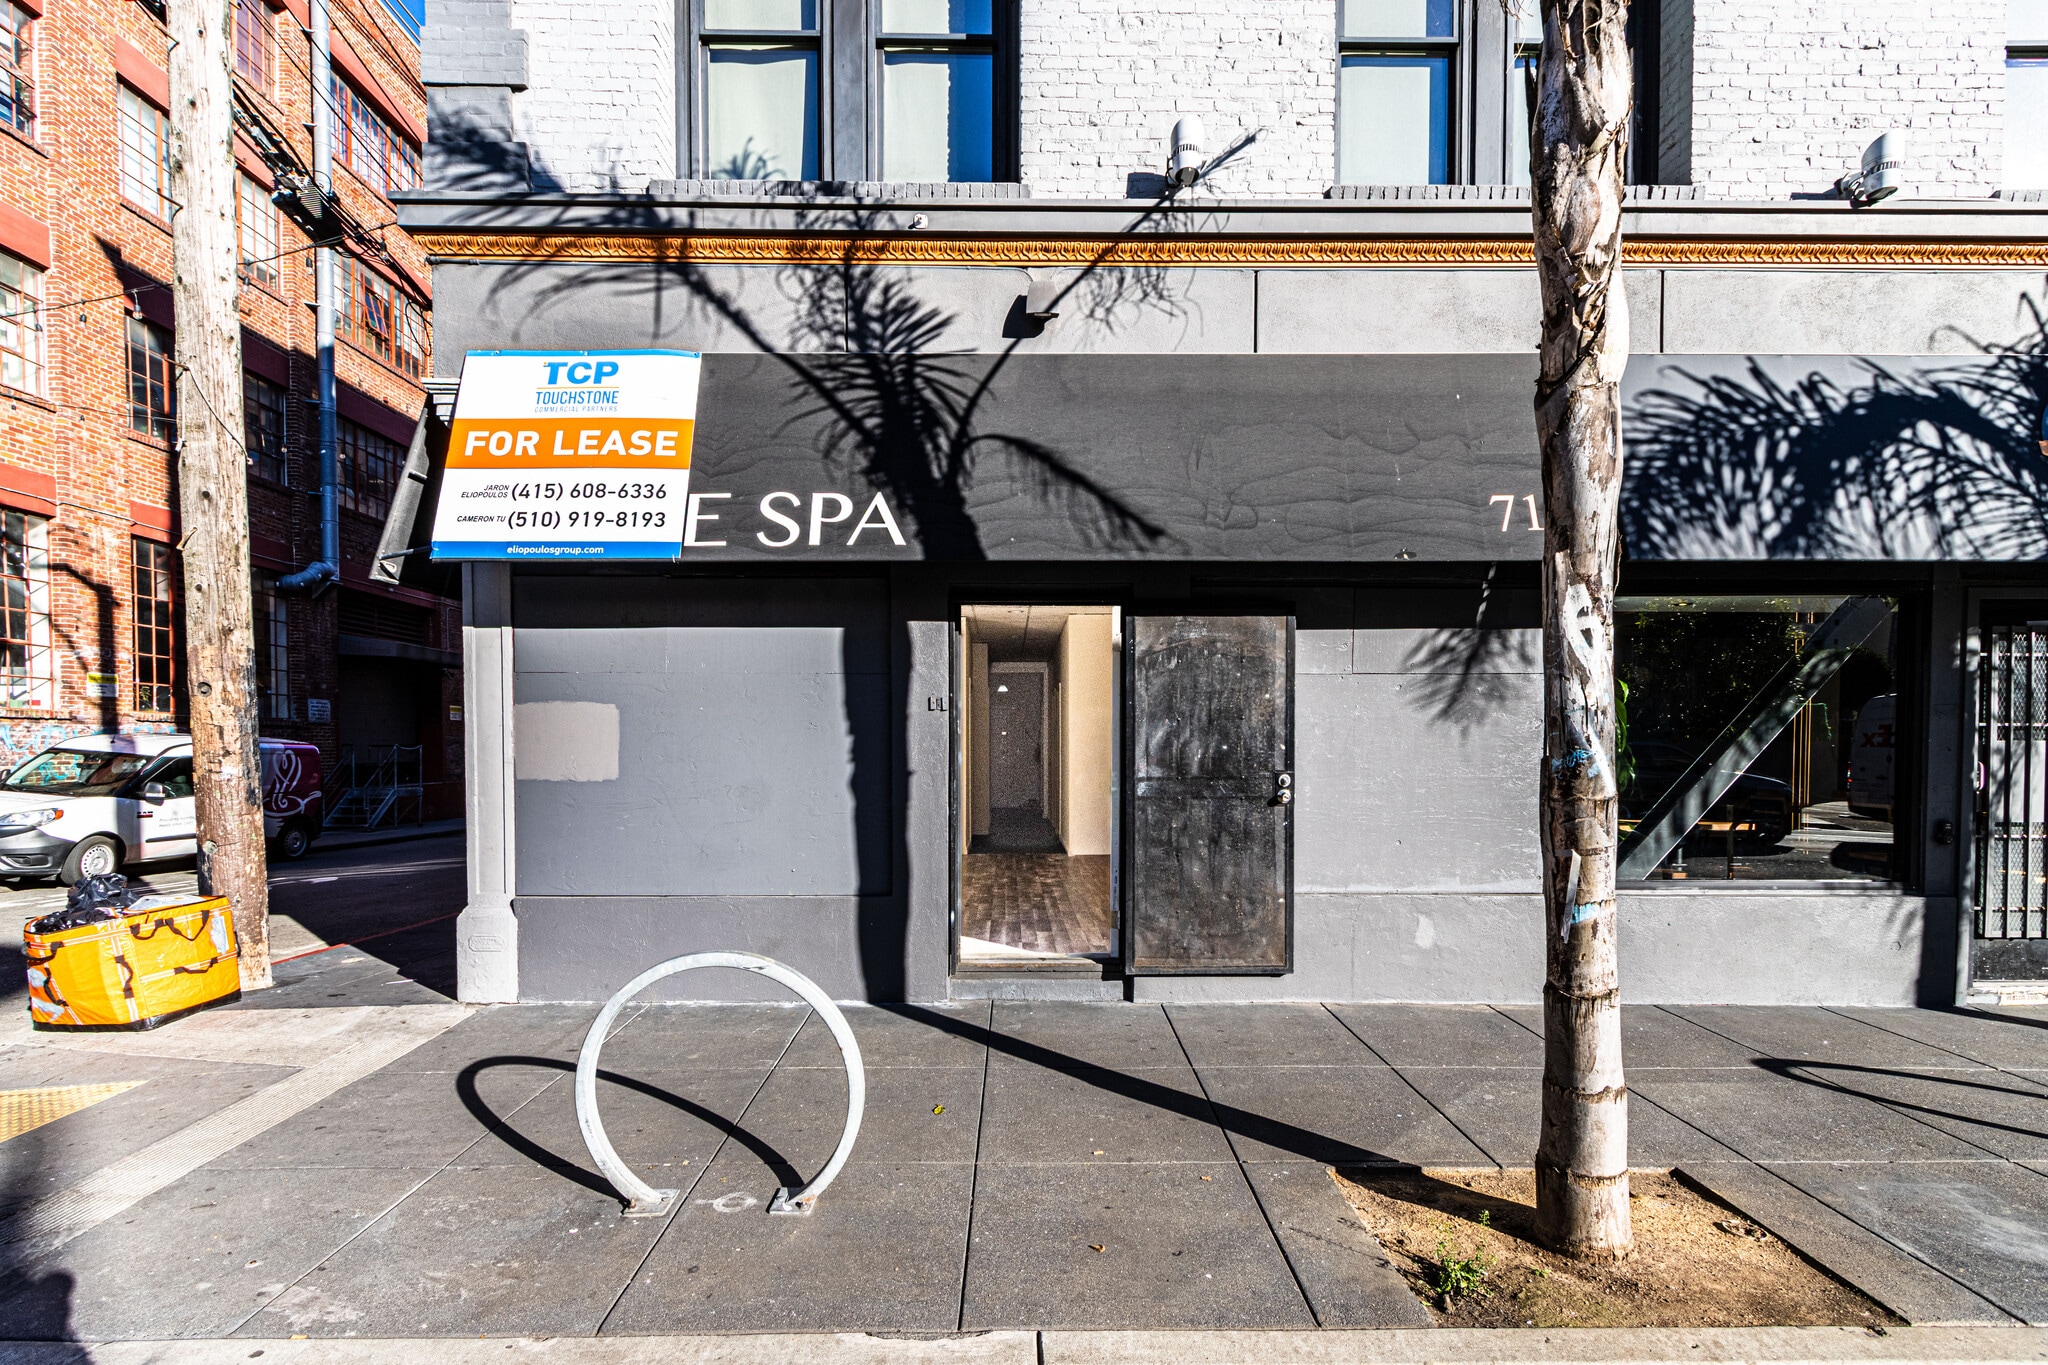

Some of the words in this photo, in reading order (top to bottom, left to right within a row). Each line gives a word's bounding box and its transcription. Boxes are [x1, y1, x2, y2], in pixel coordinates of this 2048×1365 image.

[543, 361, 619, 385] TCP
[536, 390, 620, 405] TOUCHSTONE
[535, 405, 579, 413] COMMERCIAL
[581, 405, 618, 413] PARTNERS
[464, 430, 540, 456] FOR
[553, 429, 679, 456] LEASE
[461, 491, 508, 499] ELIOPOULOS
[511, 483, 563, 501] (415)
[569, 483, 667, 500] 608-6336
[456, 515, 494, 523] CAMERON
[508, 511, 560, 530] (510)
[568, 511, 666, 528] 919-8193
[756, 491, 907, 547] SPA
[1489, 494, 1545, 532] 71
[506, 544, 604, 556] eliopoulosgroup.com
